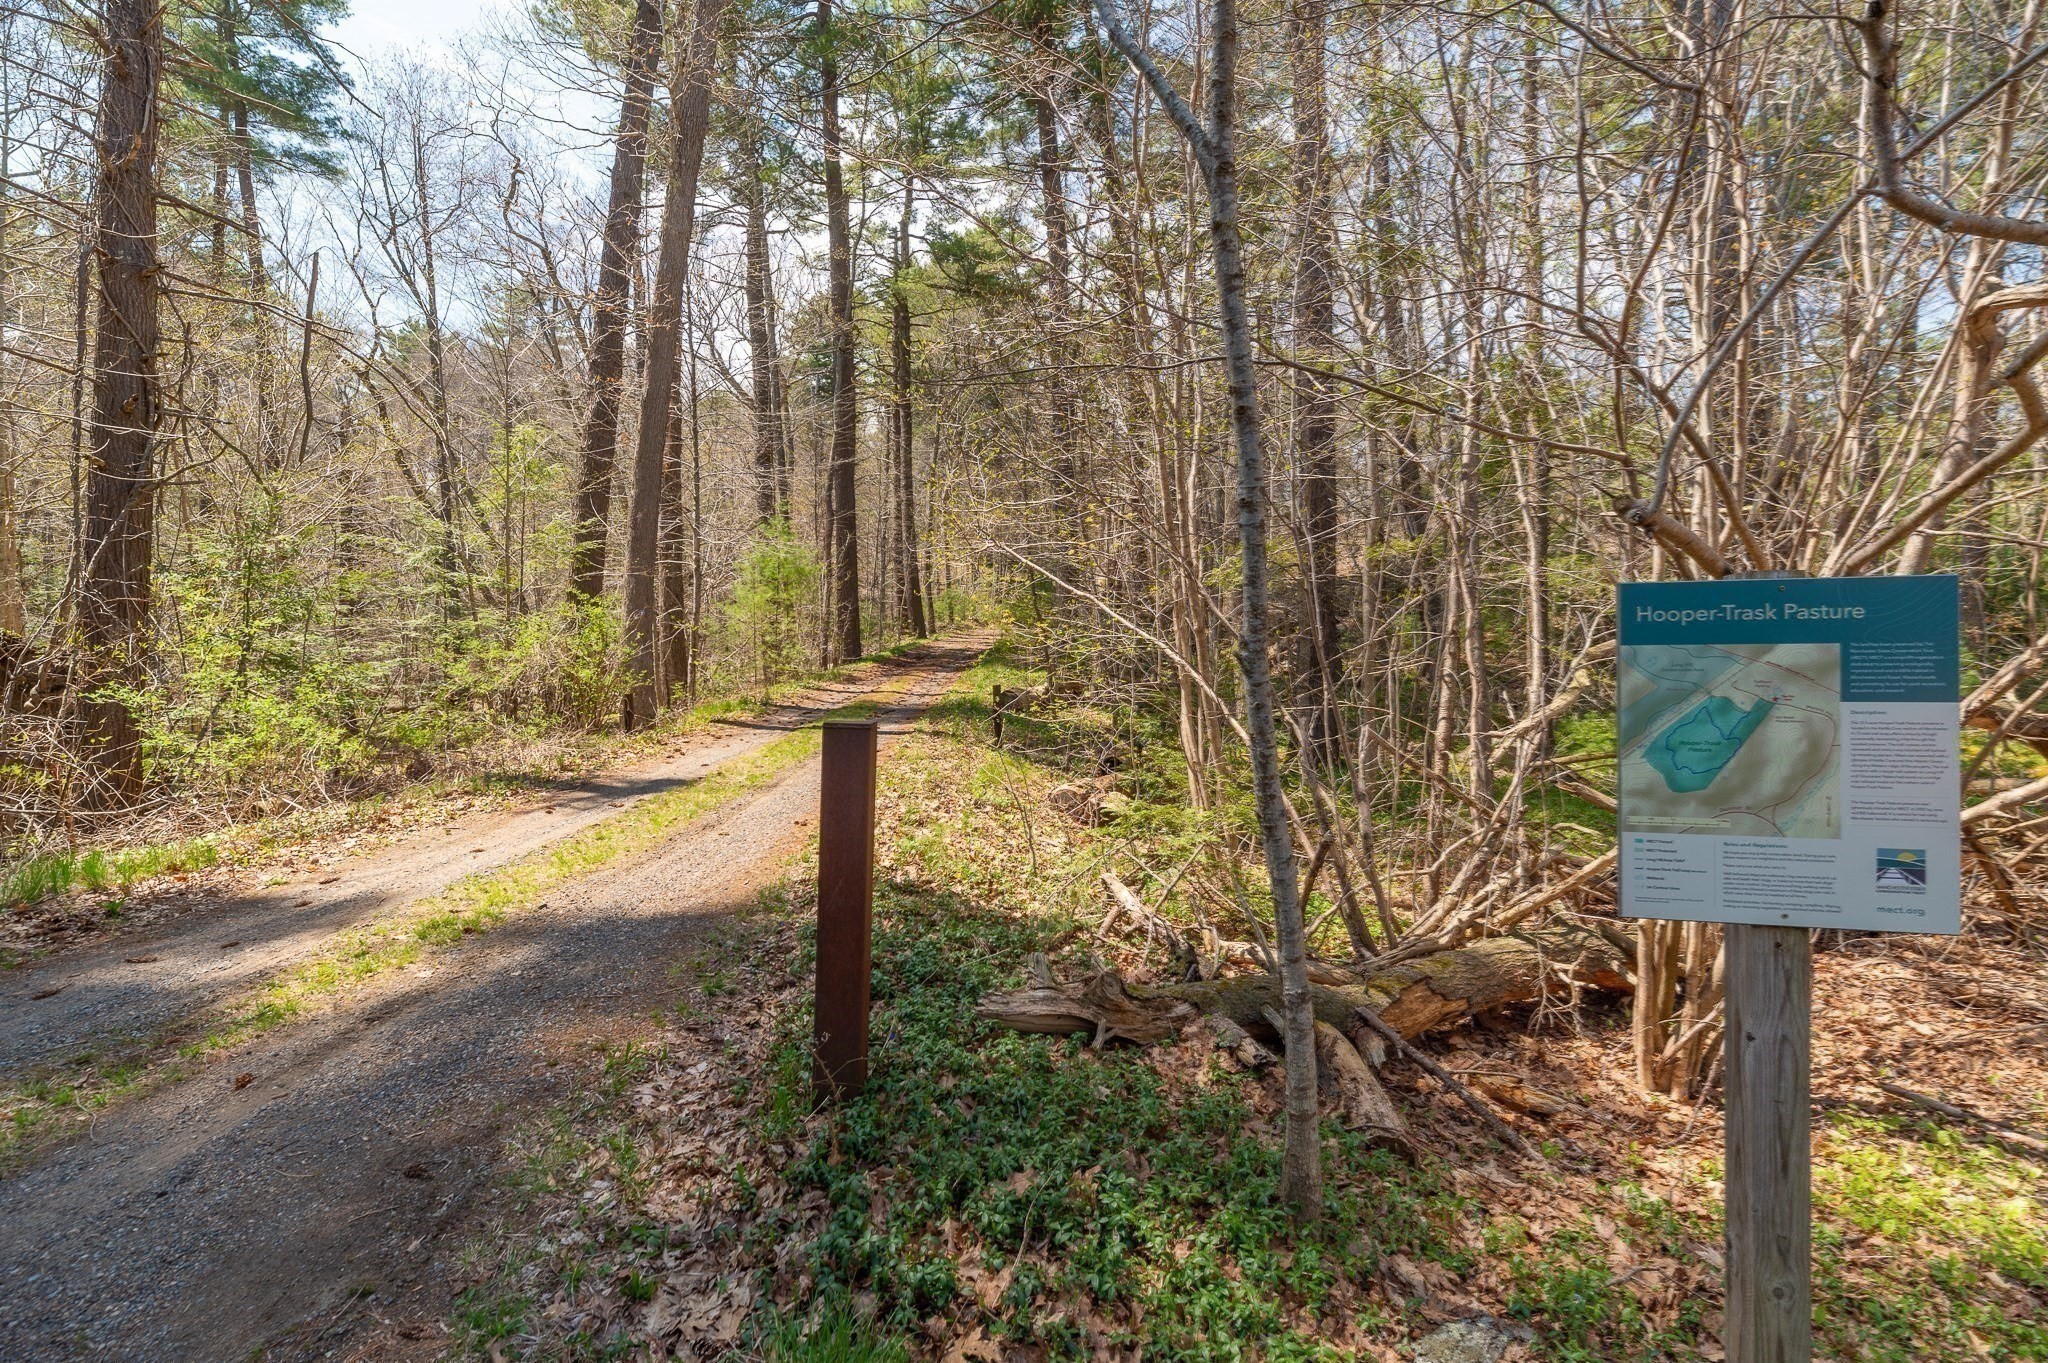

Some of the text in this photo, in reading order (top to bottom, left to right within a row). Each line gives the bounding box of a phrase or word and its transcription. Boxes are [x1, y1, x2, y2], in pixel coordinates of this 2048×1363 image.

[1635, 602, 1866, 626] Hooper-Trask Pasture
[1876, 907, 1926, 917] mect.org
